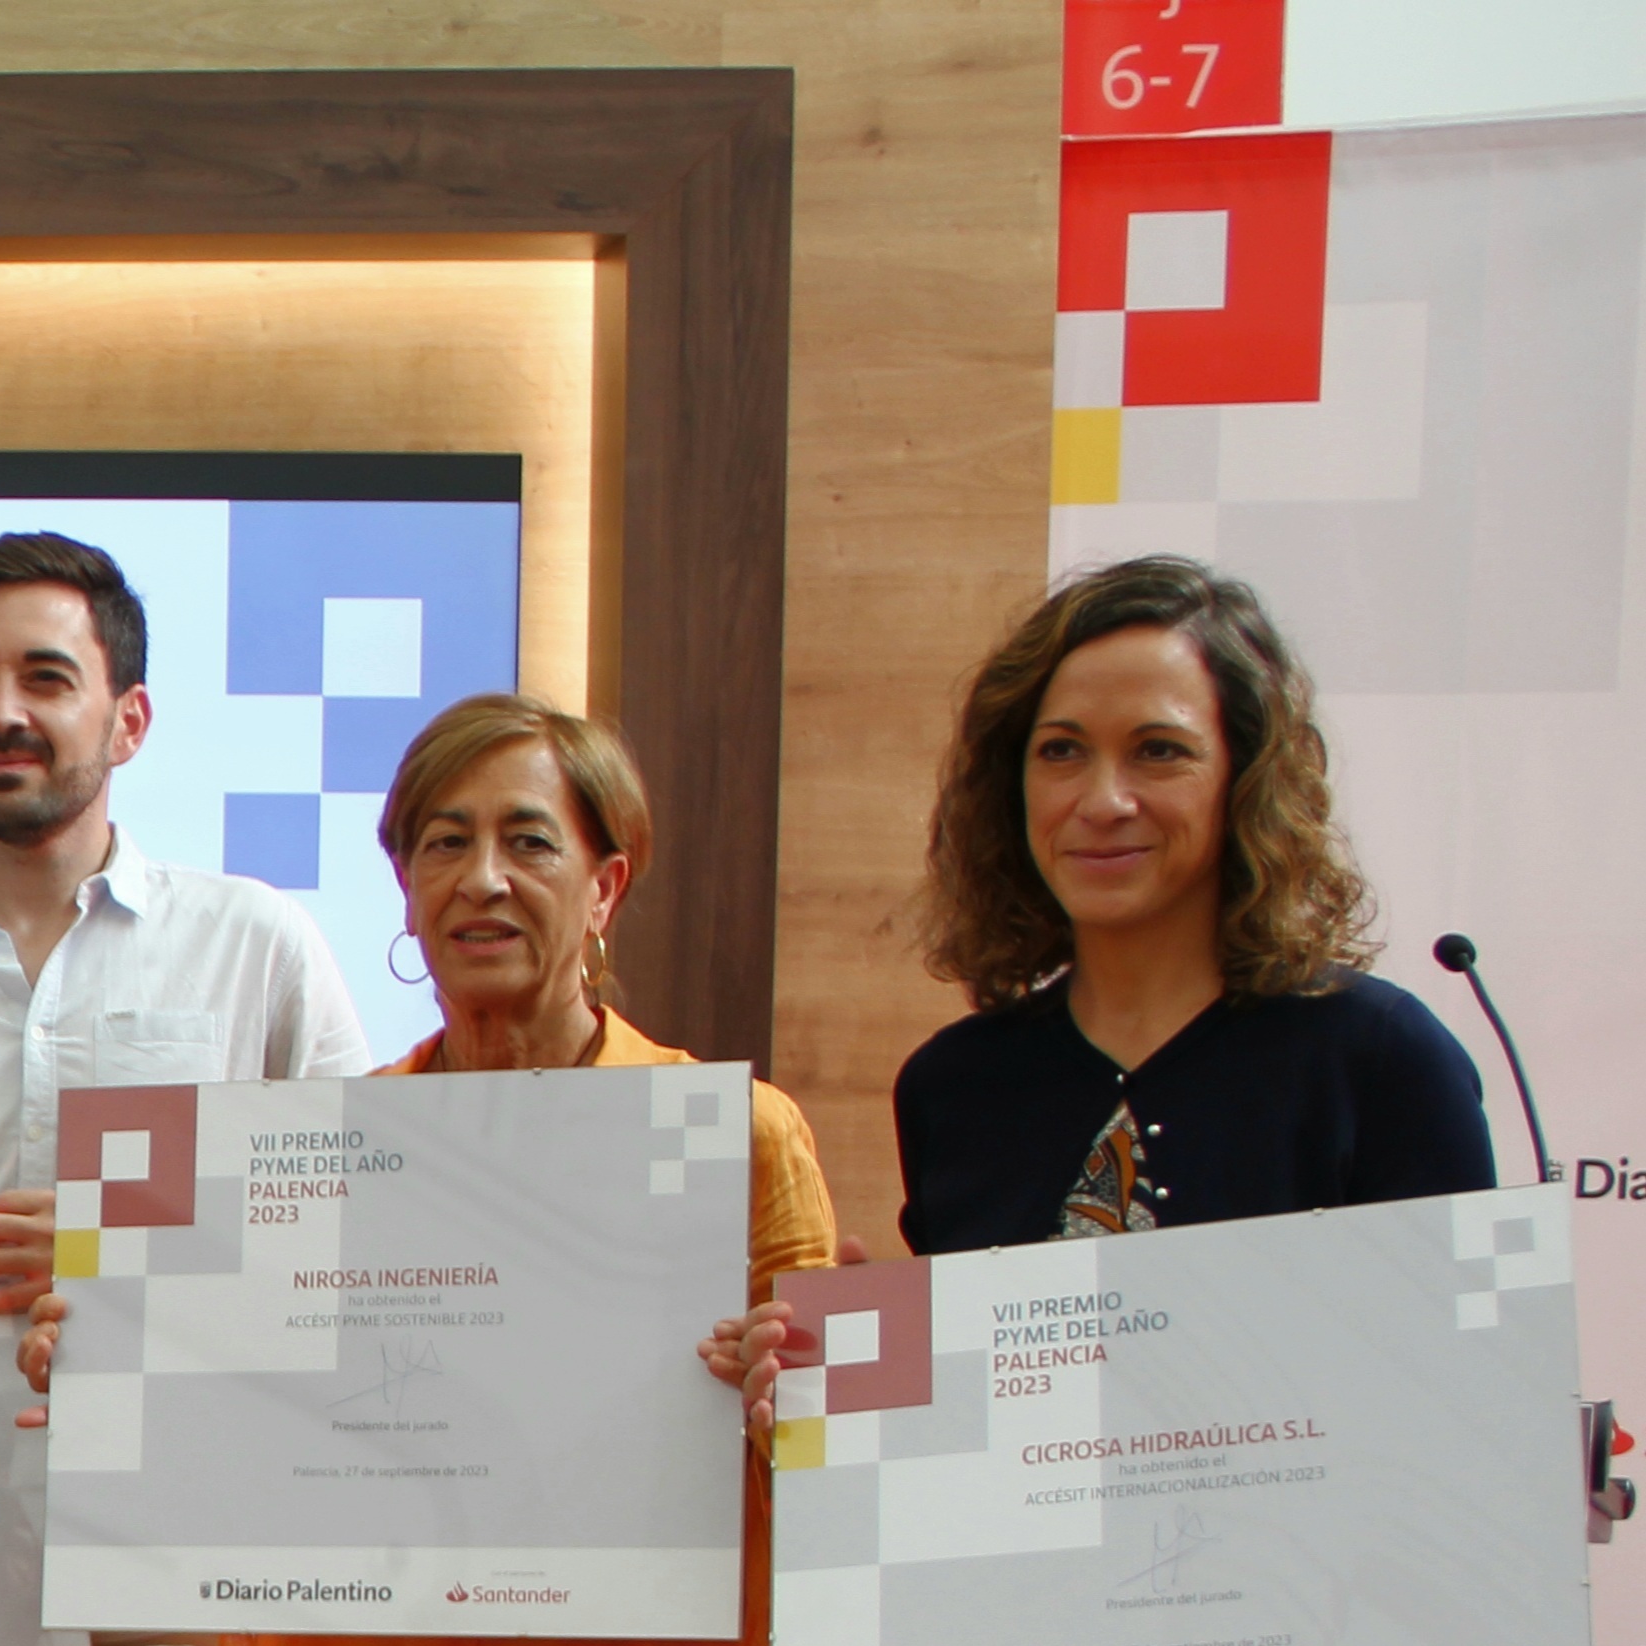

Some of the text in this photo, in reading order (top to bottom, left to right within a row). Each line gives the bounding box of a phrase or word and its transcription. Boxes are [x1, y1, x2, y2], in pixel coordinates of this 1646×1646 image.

[1102, 44, 1219, 109] 6-7
[250, 1131, 364, 1151] VII PREMIO
[250, 1149, 403, 1176] PYME DEL AÑO
[249, 1179, 349, 1199] PALENCIA
[249, 1204, 299, 1224] 2023
[293, 1263, 498, 1289] NIROSA INGENIERÍA
[348, 1293, 441, 1307] ha obtenido el
[992, 1291, 1122, 1323] VII PREMIO
[286, 1311, 504, 1328] ACCÉSIT PYME SOSTENIBLE 2023
[993, 1309, 1169, 1348] PYME DEL AÑO
[994, 1343, 1107, 1372] PALENCIA
[994, 1374, 1051, 1398] 2023
[332, 1420, 448, 1433] Presidente del jurado
[1022, 1418, 1326, 1465] CICROSA HIDRAÚLICA S.L.
[345, 1466, 359, 1477] 27
[361, 1466, 375, 1476] de
[377, 1465, 441, 1481] septiembre
[443, 1465, 457, 1476] de
[459, 1465, 489, 1476] 2023
[1118, 1453, 1227, 1476] ha obtenido el
[1025, 1466, 1325, 1506] ACCÉSIT INTERNACIONALIZACIÓN 2023
[216, 1578, 392, 1602] Diario Palentino
[473, 1584, 570, 1603] Santander
[1106, 1589, 1242, 1610] Presidente del jurado
